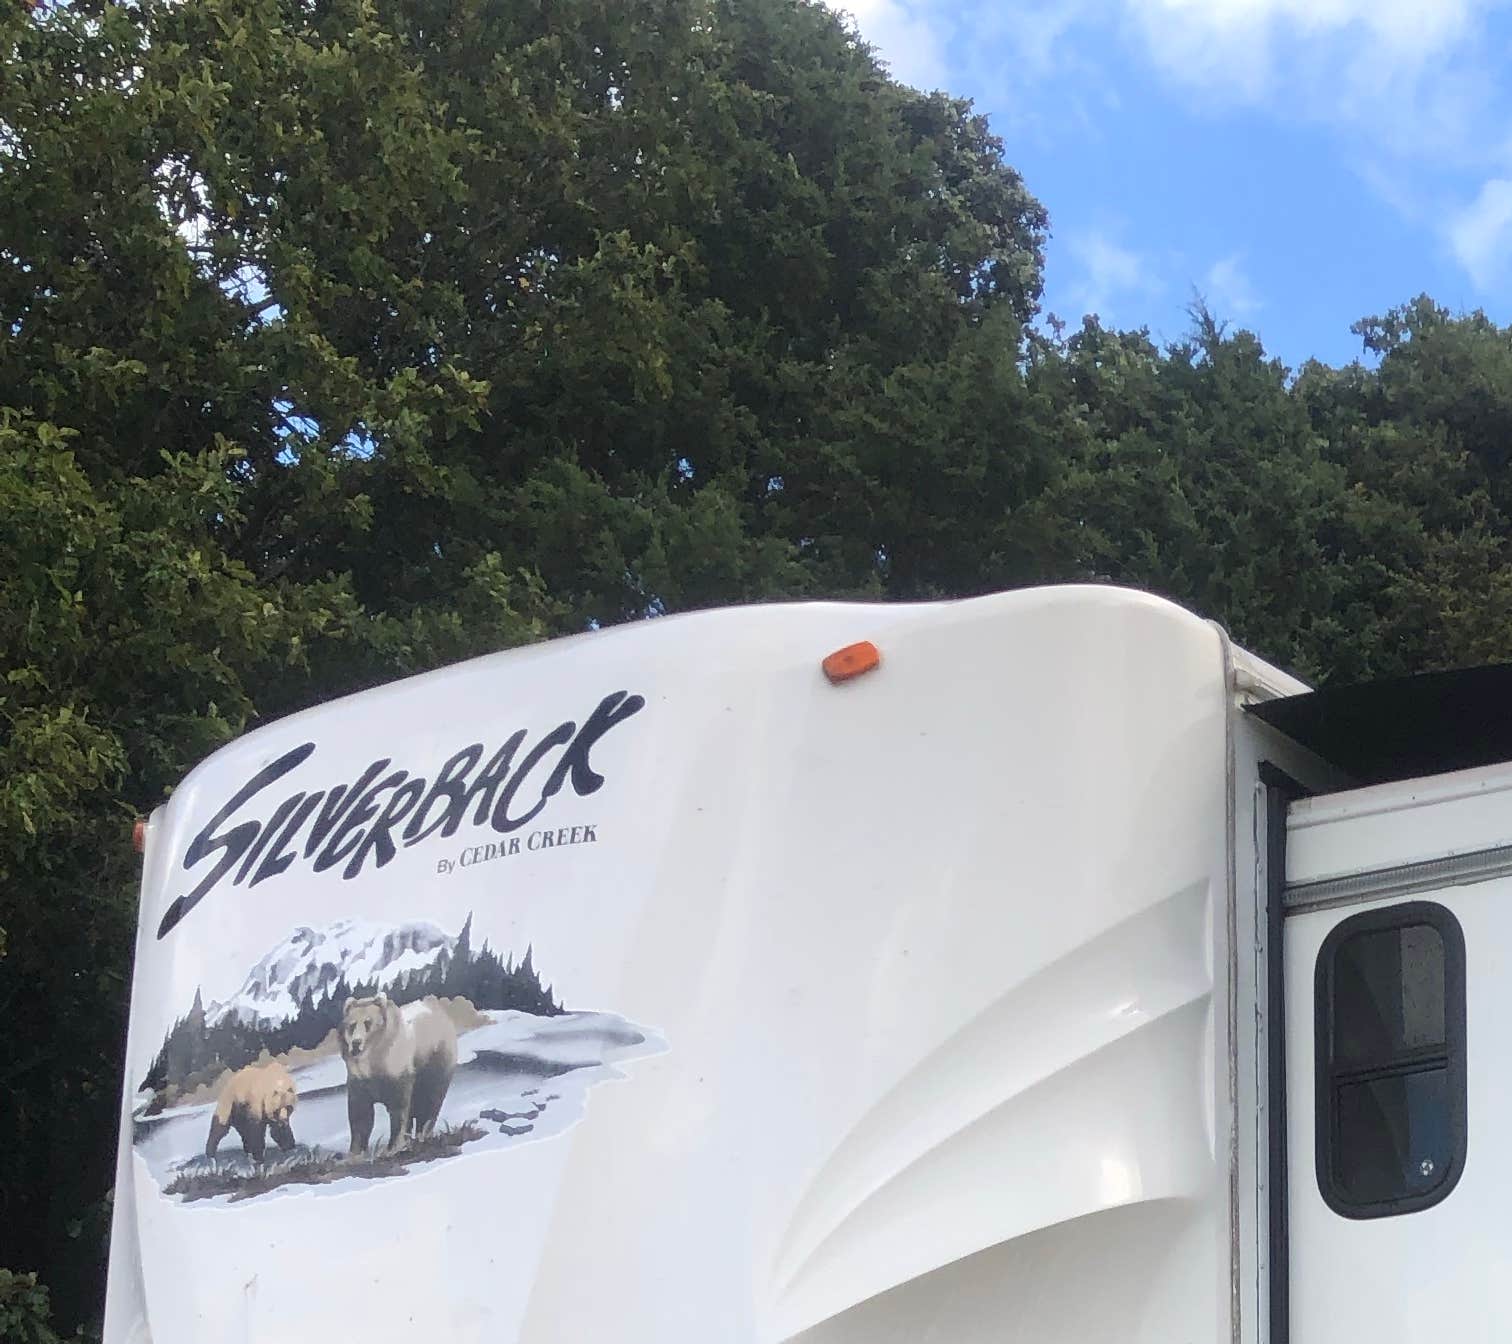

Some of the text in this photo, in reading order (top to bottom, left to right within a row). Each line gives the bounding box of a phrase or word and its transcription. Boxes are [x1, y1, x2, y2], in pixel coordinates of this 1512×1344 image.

[157, 690, 646, 940] SILVERBACK
[437, 824, 598, 874] By CEDAR CREEK
